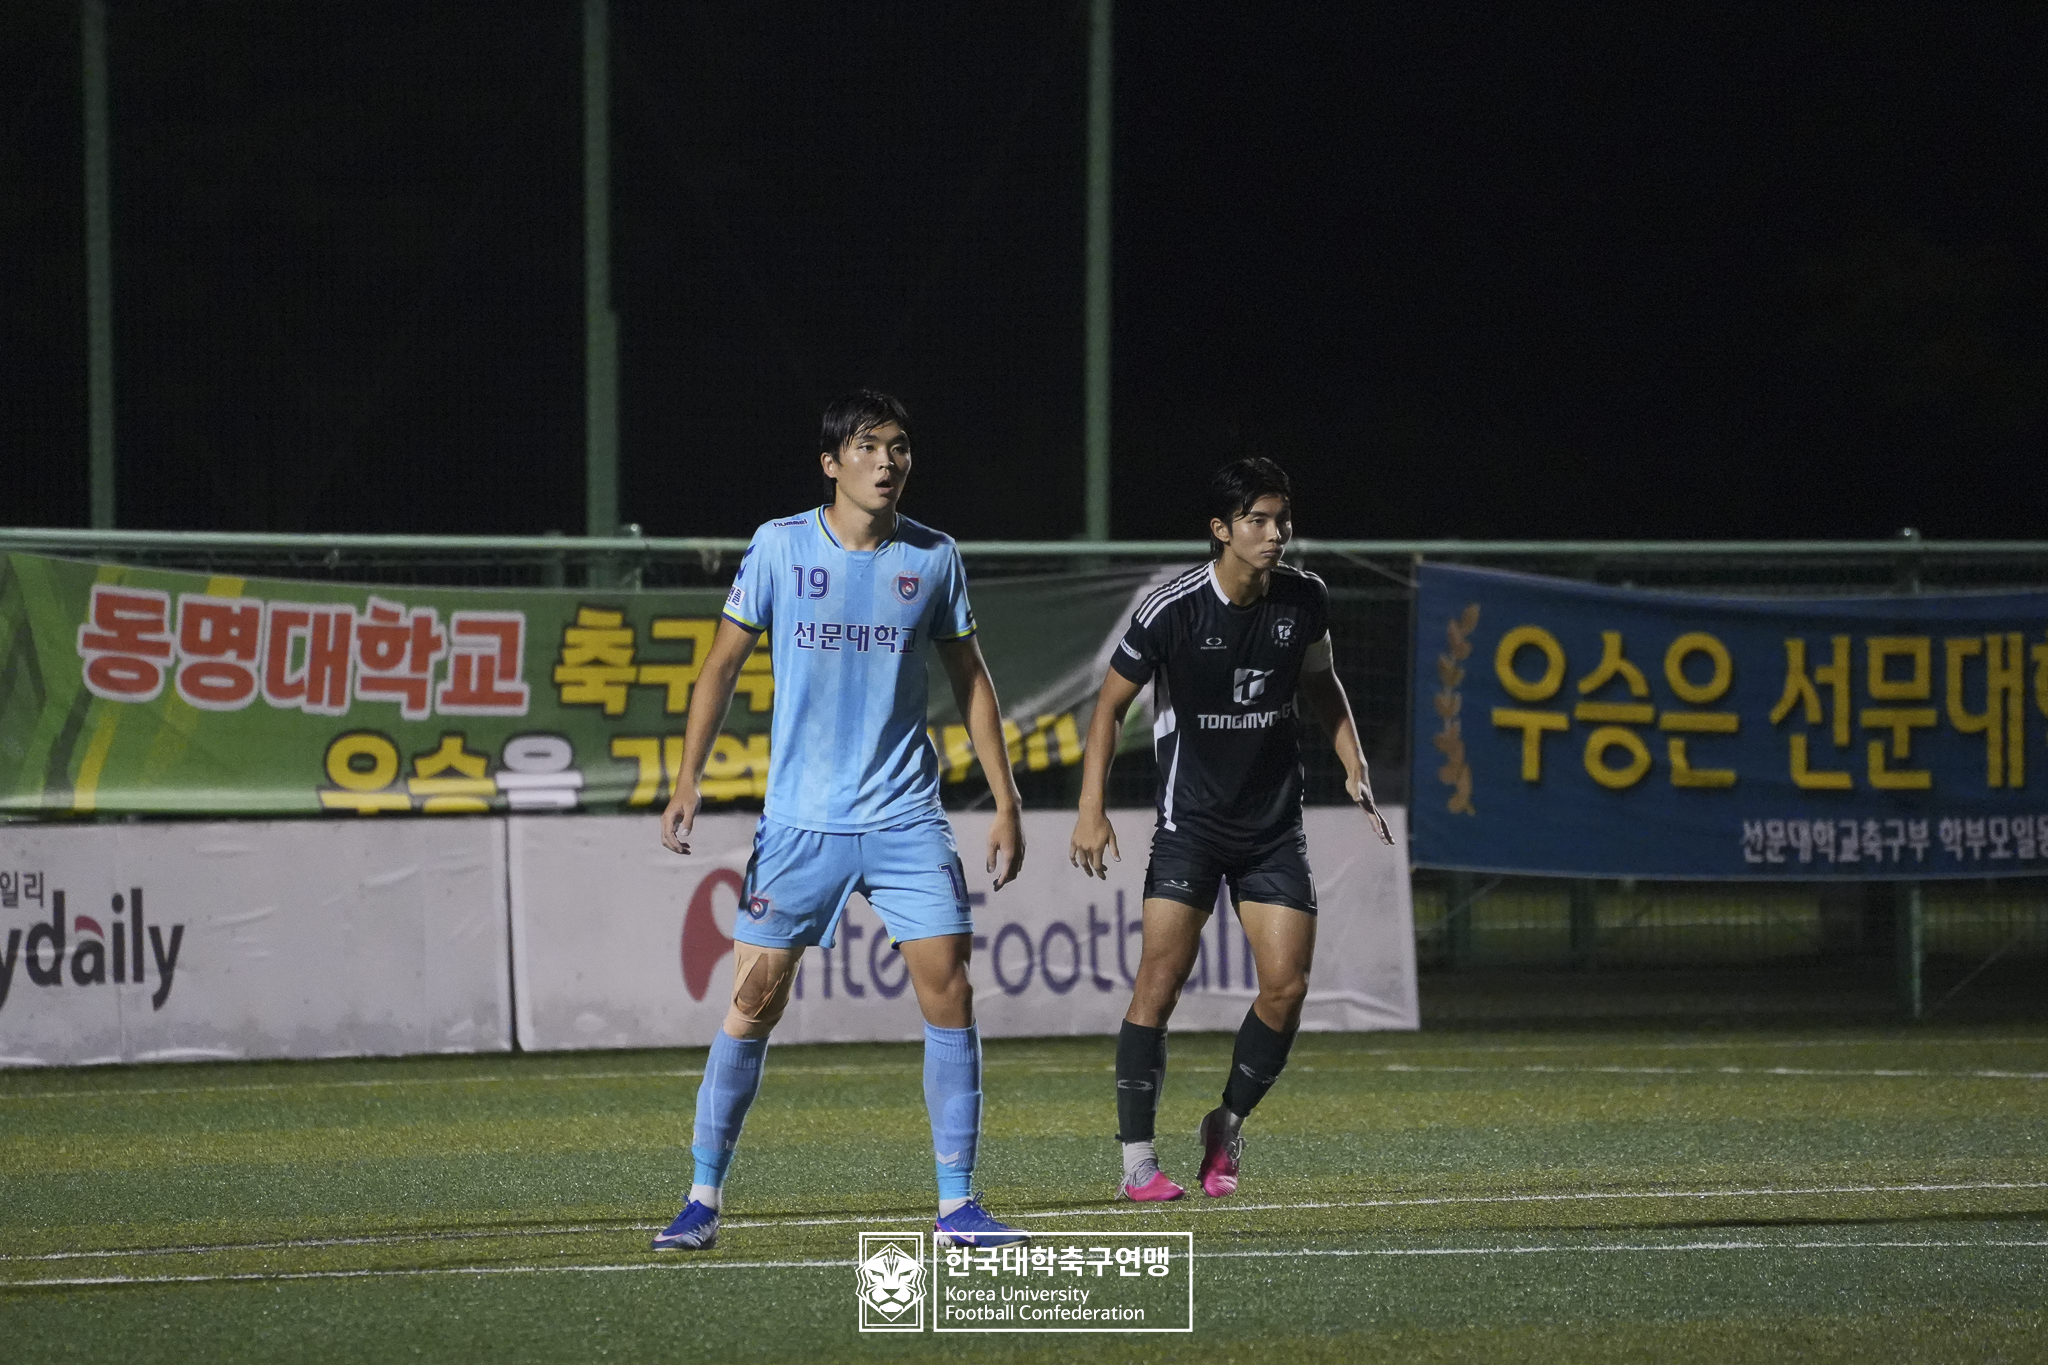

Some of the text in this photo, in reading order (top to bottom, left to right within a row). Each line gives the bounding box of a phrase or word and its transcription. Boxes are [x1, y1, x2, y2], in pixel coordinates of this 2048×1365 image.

[792, 565, 829, 599] 19
[77, 584, 530, 720] 동명대학교
[793, 620, 918, 654] 선문대학교
[1491, 624, 1739, 790] 우승은
